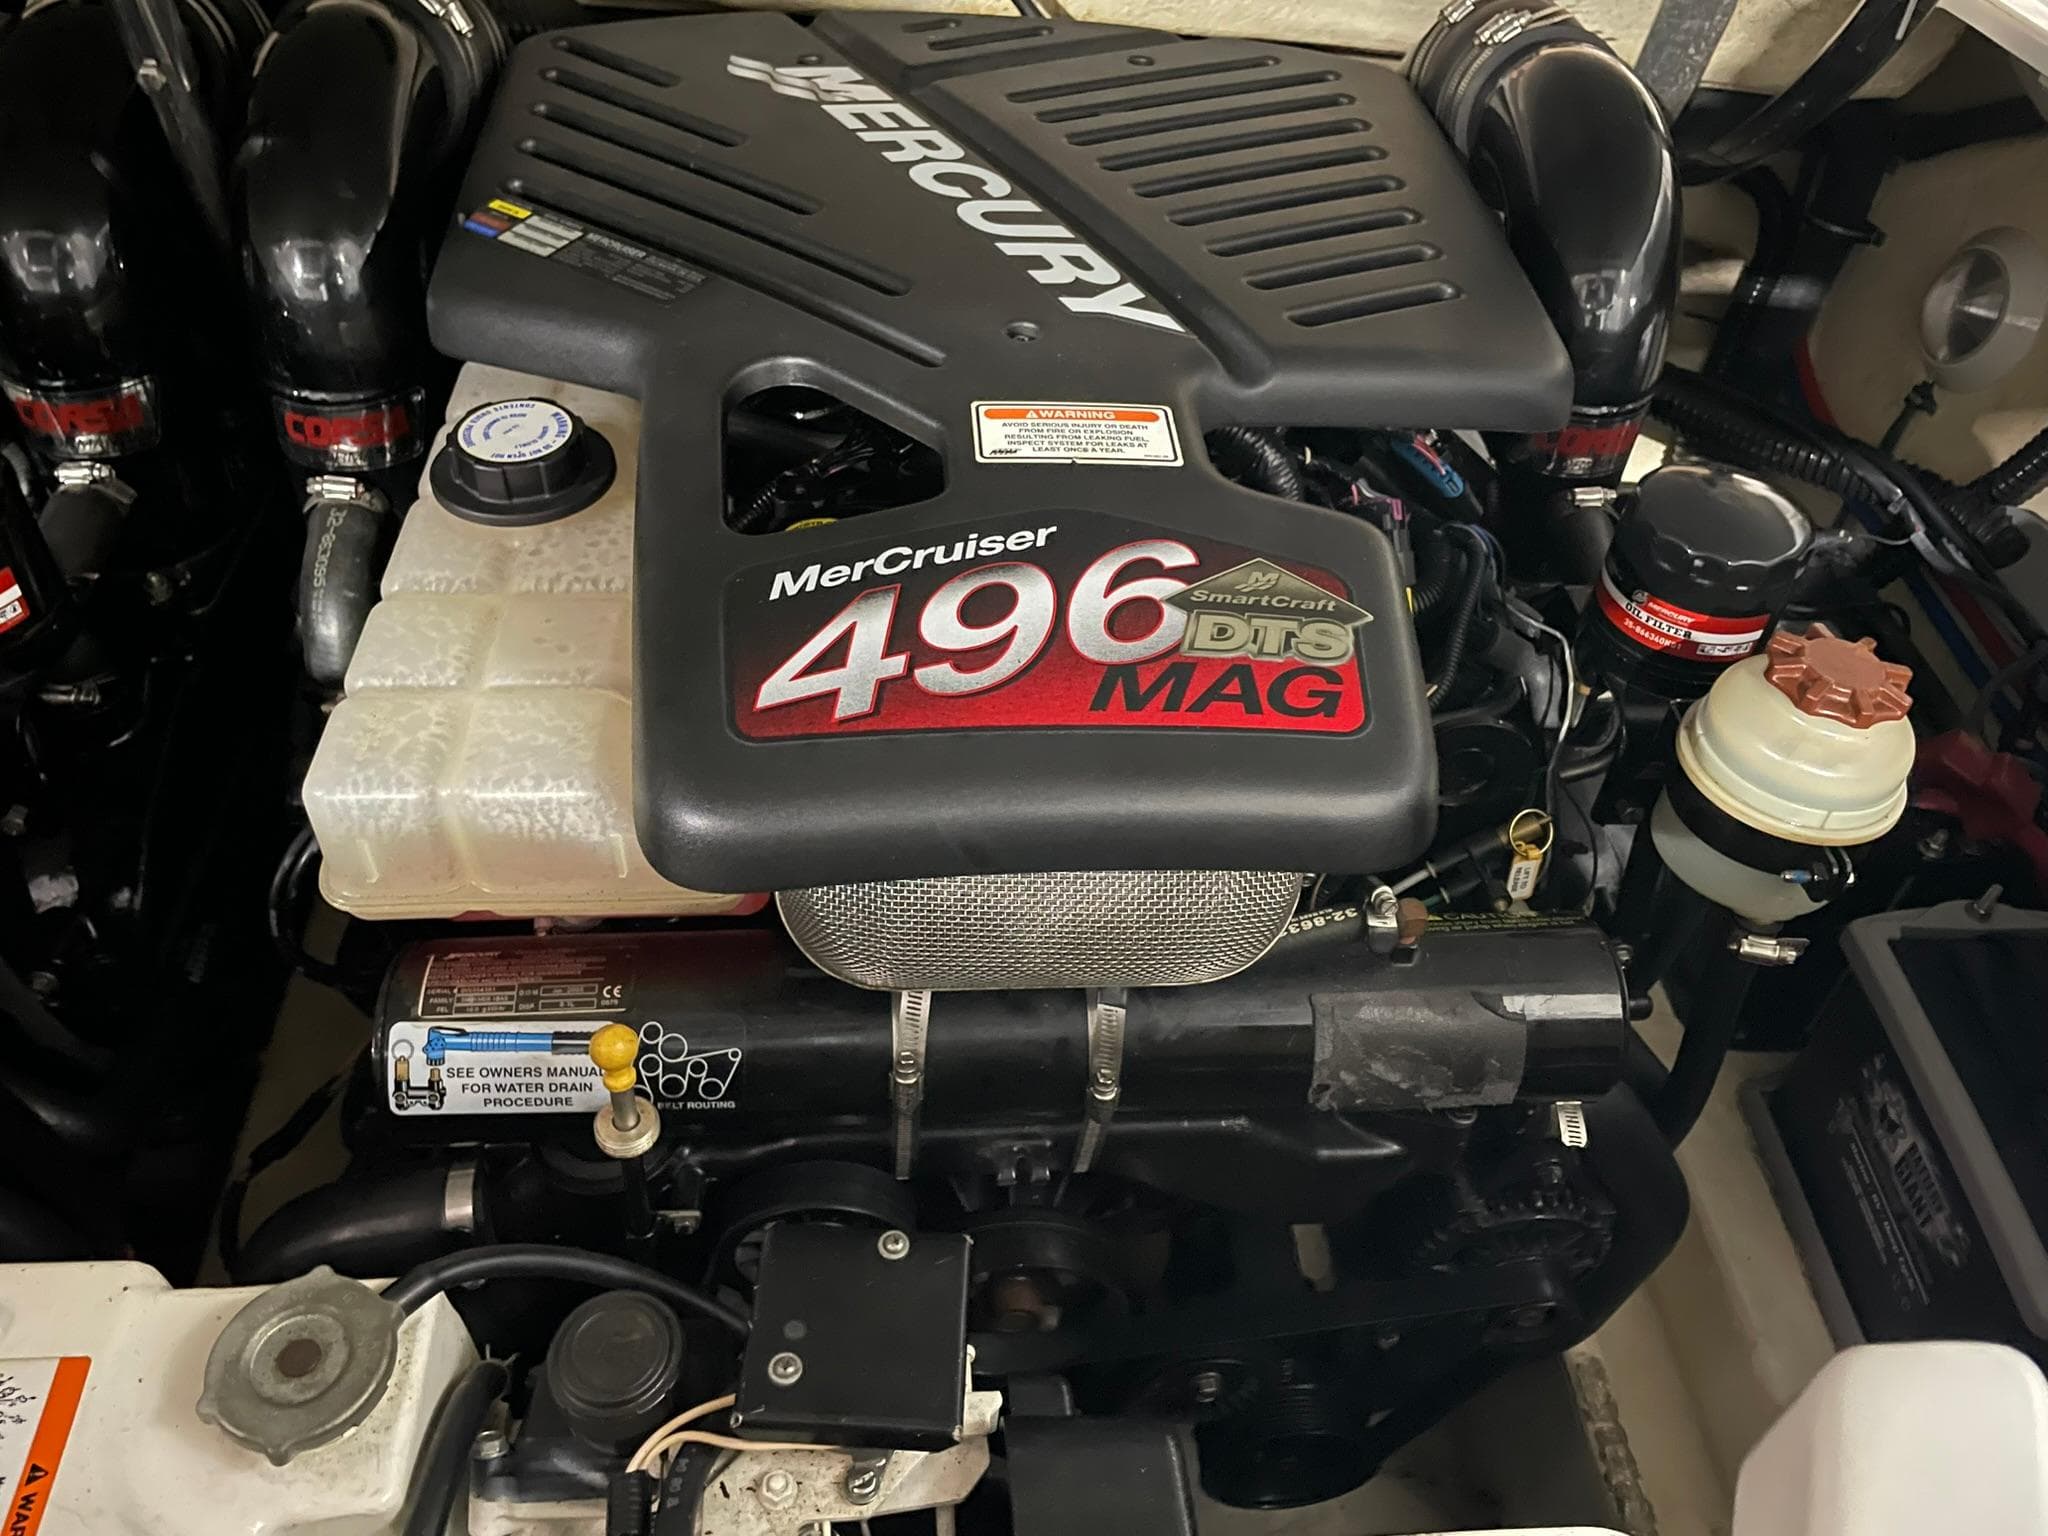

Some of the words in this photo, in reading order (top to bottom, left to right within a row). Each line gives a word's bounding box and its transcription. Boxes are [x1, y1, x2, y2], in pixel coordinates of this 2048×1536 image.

[728, 56, 1187, 332] MERCURY
[1039, 410, 1116, 420] WARNING
[768, 523, 1058, 601] MerCruiser
[1190, 589, 1337, 613] SmartCraft
[754, 538, 1201, 721] 496
[1625, 602, 1643, 619] OIL
[1645, 615, 1692, 639] FILTER
[1193, 612, 1351, 661] DTS
[1087, 661, 1345, 719] MAG
[446, 1066, 475, 1079] SEE
[479, 1066, 543, 1079] OWNERS
[461, 1083, 492, 1095] FOR
[495, 1082, 546, 1094] WATER
[548, 1082, 593, 1093] DRAIN
[483, 1096, 574, 1108] PROCEDURE
[657, 1101, 685, 1110] BELT
[687, 1101, 736, 1109] ROUTING
